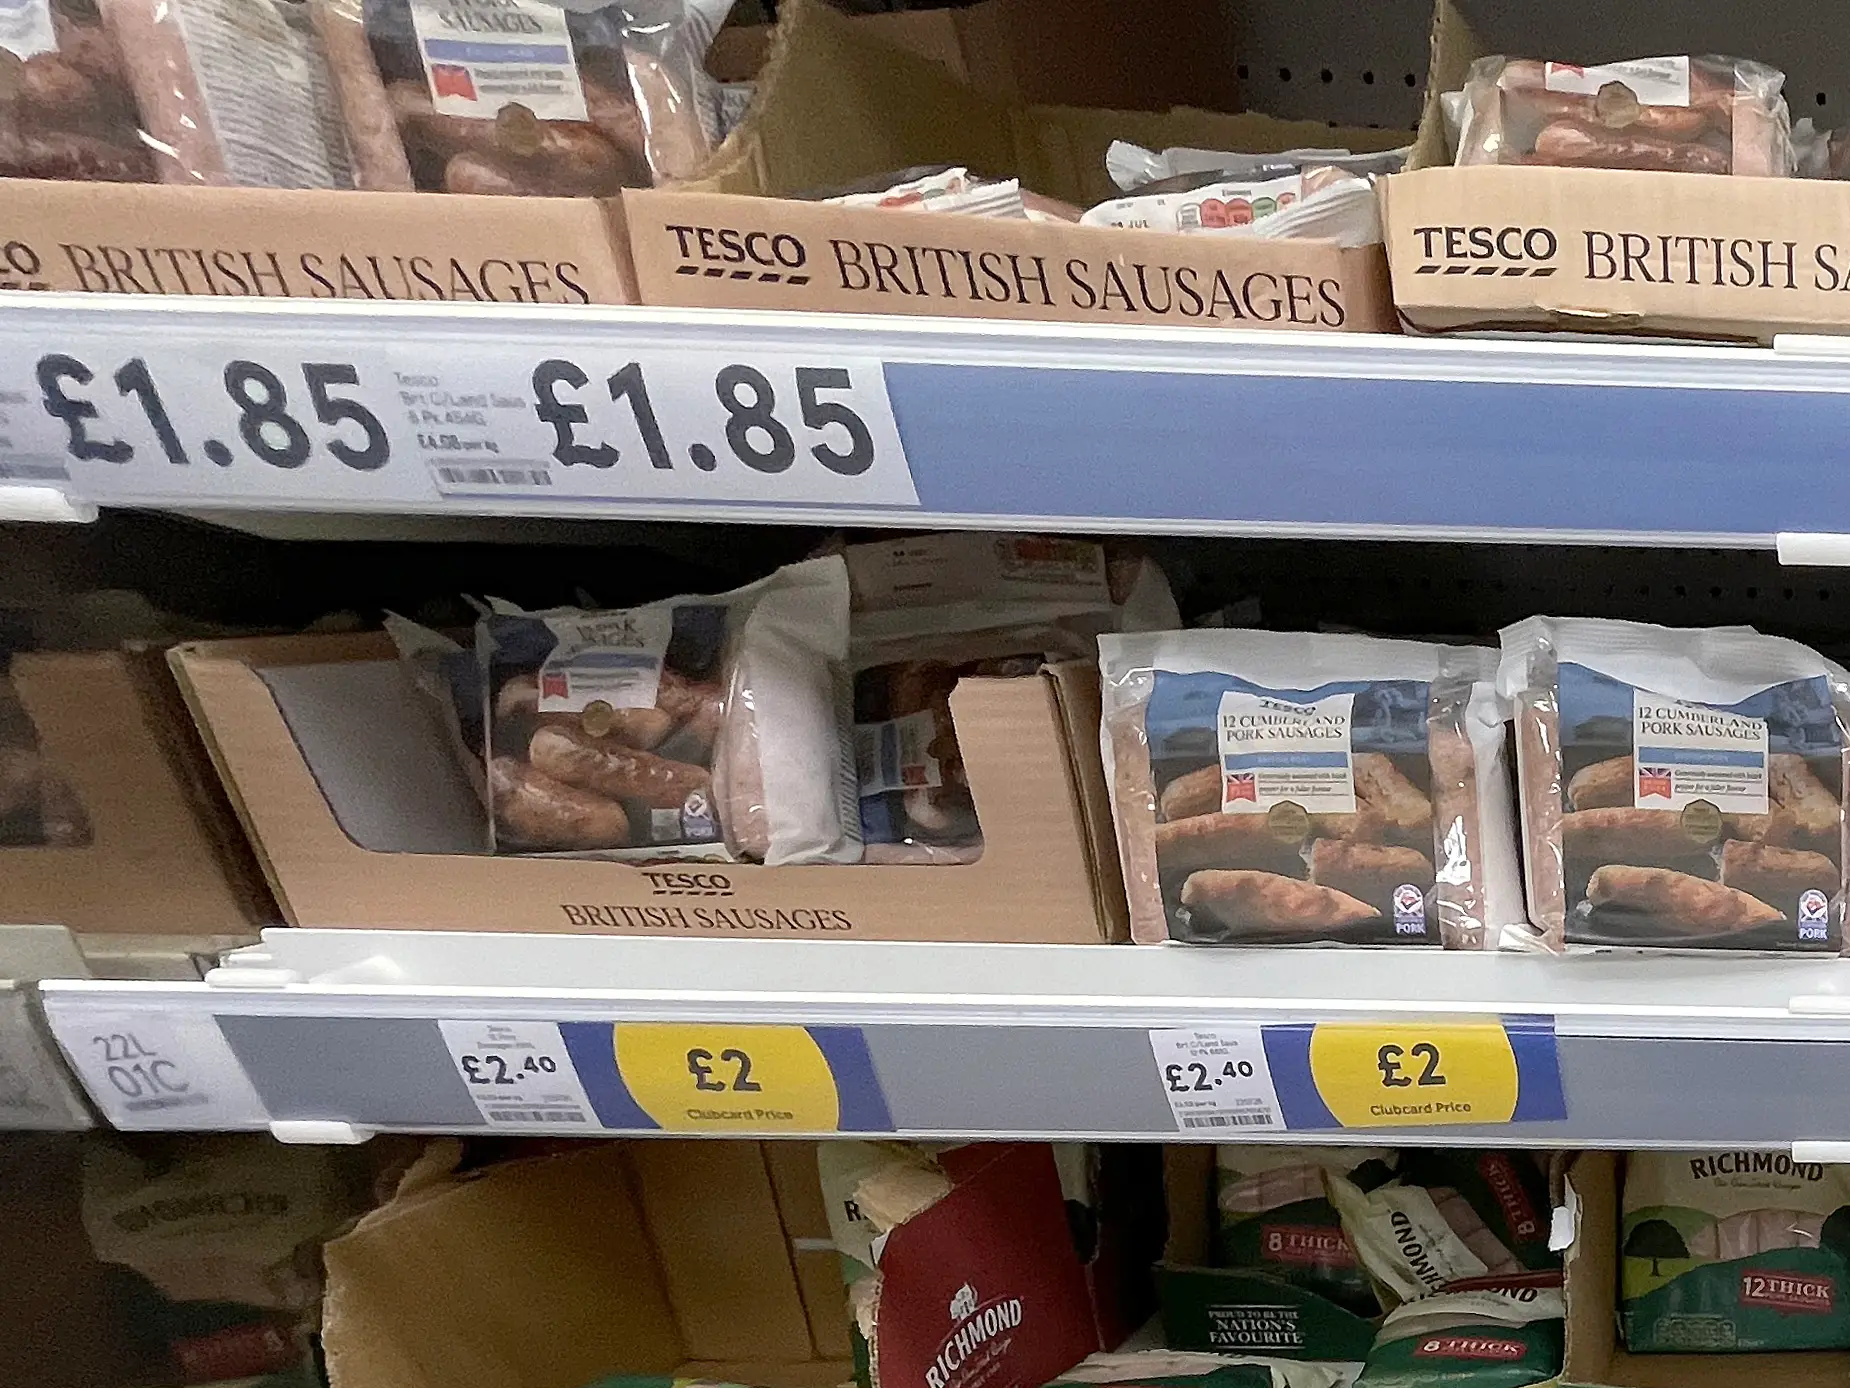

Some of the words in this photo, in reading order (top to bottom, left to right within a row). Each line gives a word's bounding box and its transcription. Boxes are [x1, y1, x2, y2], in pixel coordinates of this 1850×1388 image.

[1414, 227, 1558, 261] TESCO
[1583, 231, 1796, 288] BRITISH
[58, 243, 290, 296] BRITISH
[301, 252, 589, 308] SAUSAGES
[666, 225, 806, 268] TESCO
[828, 239, 1054, 305] BRITISH
[1067, 259, 1345, 326] SAUSAGES
[36, 353, 390, 471] £1.85
[532, 358, 874, 475] £1.85
[1639, 706, 1653, 719] 12
[1656, 707, 1763, 731] CUMBERLAND
[1641, 721, 1683, 735] PORK
[1686, 723, 1761, 740] SAUSAGES
[1227, 728, 1265, 742] PORK
[1267, 727, 1342, 741] SAUSAGES
[643, 872, 732, 890] TESCO
[561, 904, 688, 928] BRITISH
[697, 909, 852, 931] SAUSAGES
[1395, 922, 1425, 935] PORK
[1799, 927, 1828, 939] PORK
[462, 1055, 556, 1085] £2.40
[687, 1049, 761, 1092] £2
[1166, 1061, 1253, 1092] £2.40
[1378, 1042, 1446, 1088] £2
[108, 1060, 189, 1097] 01C
[688, 1109, 752, 1120] Clubcard
[755, 1109, 793, 1120] Price
[1371, 1103, 1432, 1116] Clubcard
[1435, 1102, 1471, 1114] Price
[1743, 1276, 1765, 1297] 12
[1769, 1281, 1830, 1298] THICK
[1210, 1331, 1303, 1344] FAVOURITE
[1216, 1319, 1296, 1331] NATION'S
